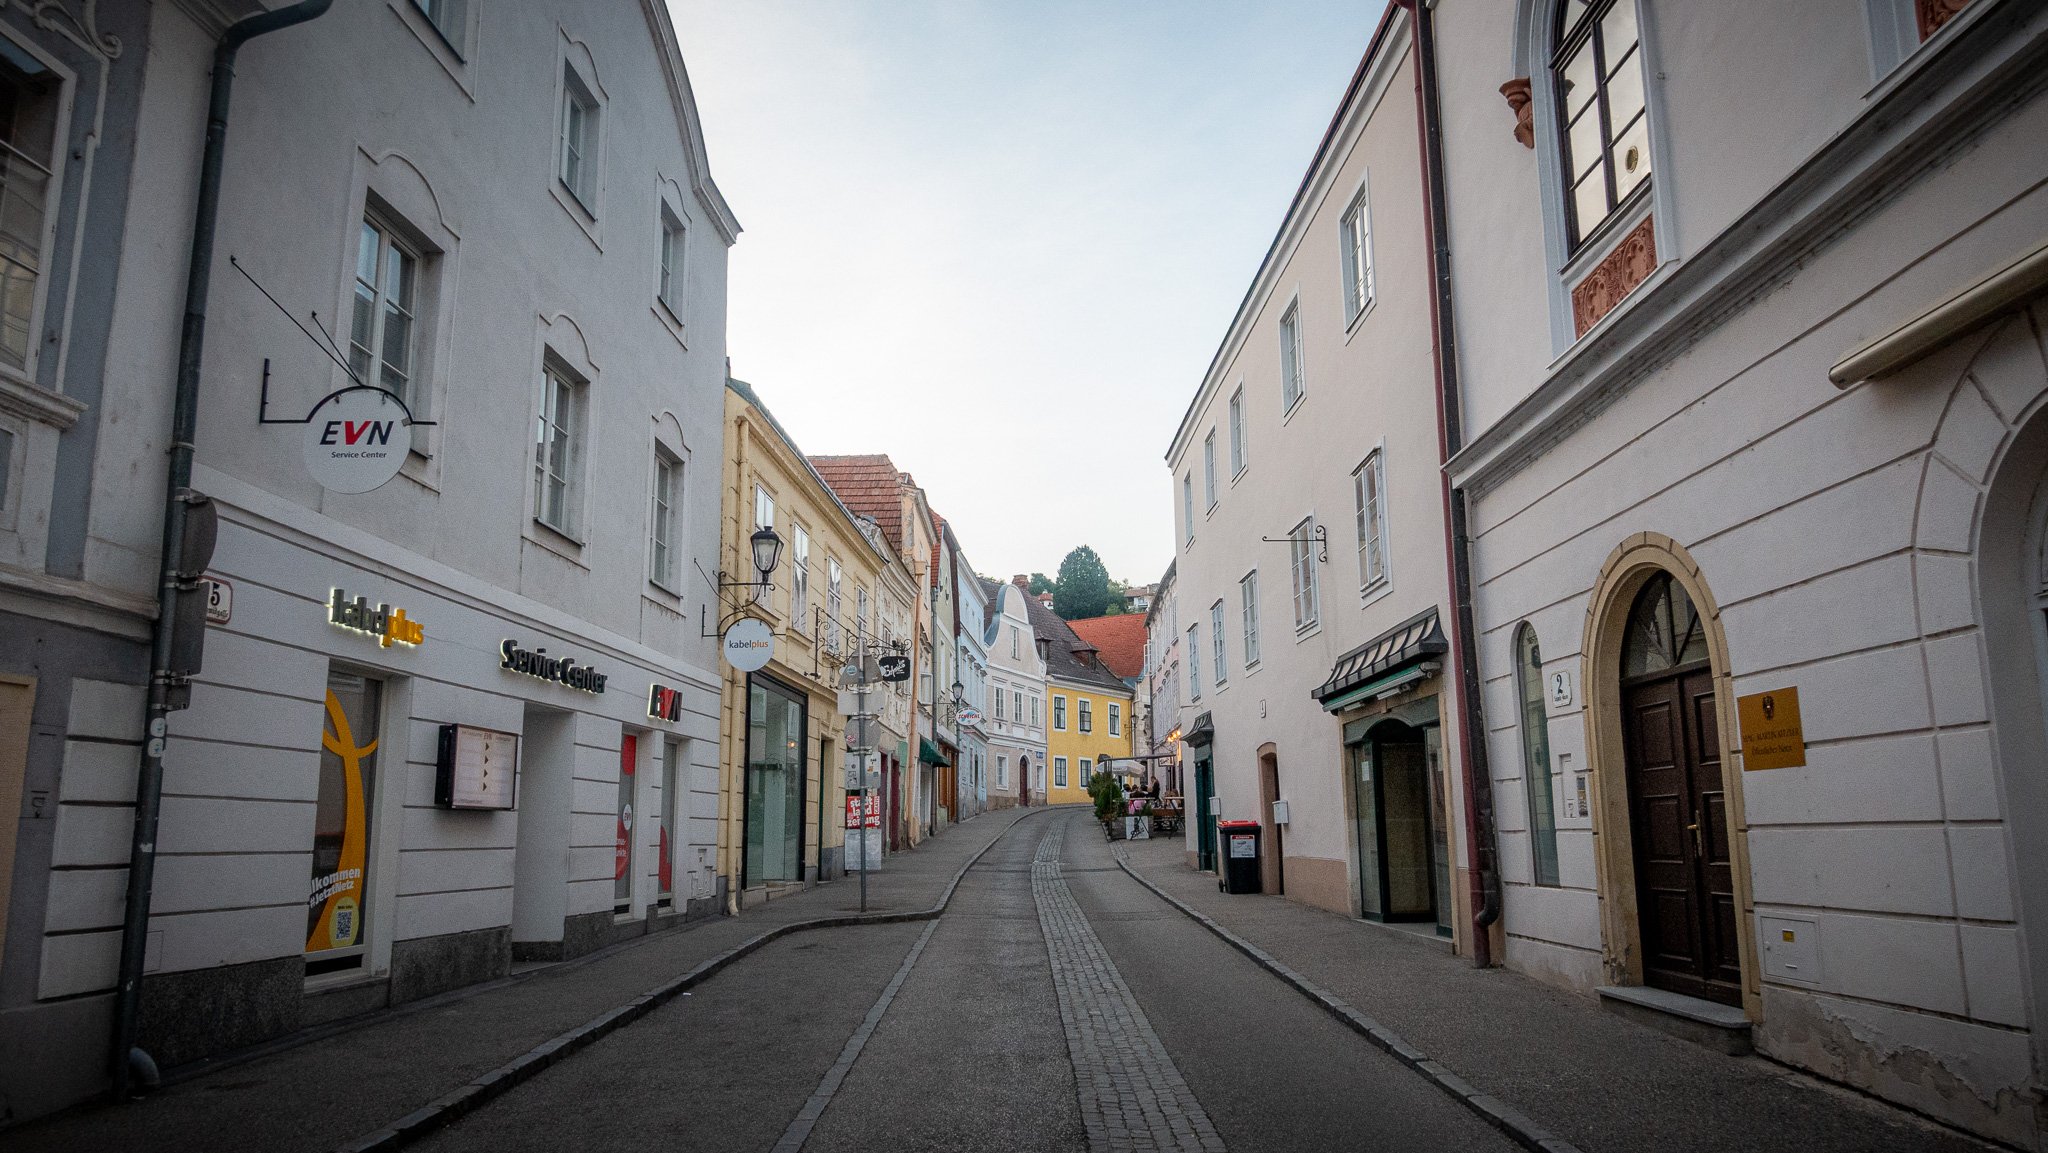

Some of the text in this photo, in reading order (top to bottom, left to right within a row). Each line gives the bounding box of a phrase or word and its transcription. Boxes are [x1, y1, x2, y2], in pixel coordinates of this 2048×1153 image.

[319, 420, 394, 445] EVN
[331, 451, 387, 459] Service Center
[210, 582, 220, 606] 5
[329, 587, 424, 648] kabelplus
[729, 640, 769, 650] kabelplus
[500, 638, 608, 694] Service Center
[1556, 674, 1563, 695] 2
[647, 683, 683, 722] EVN
[847, 815, 880, 827] zeiung
[852, 805, 872, 816] lad
[311, 868, 360, 893] lkommen
